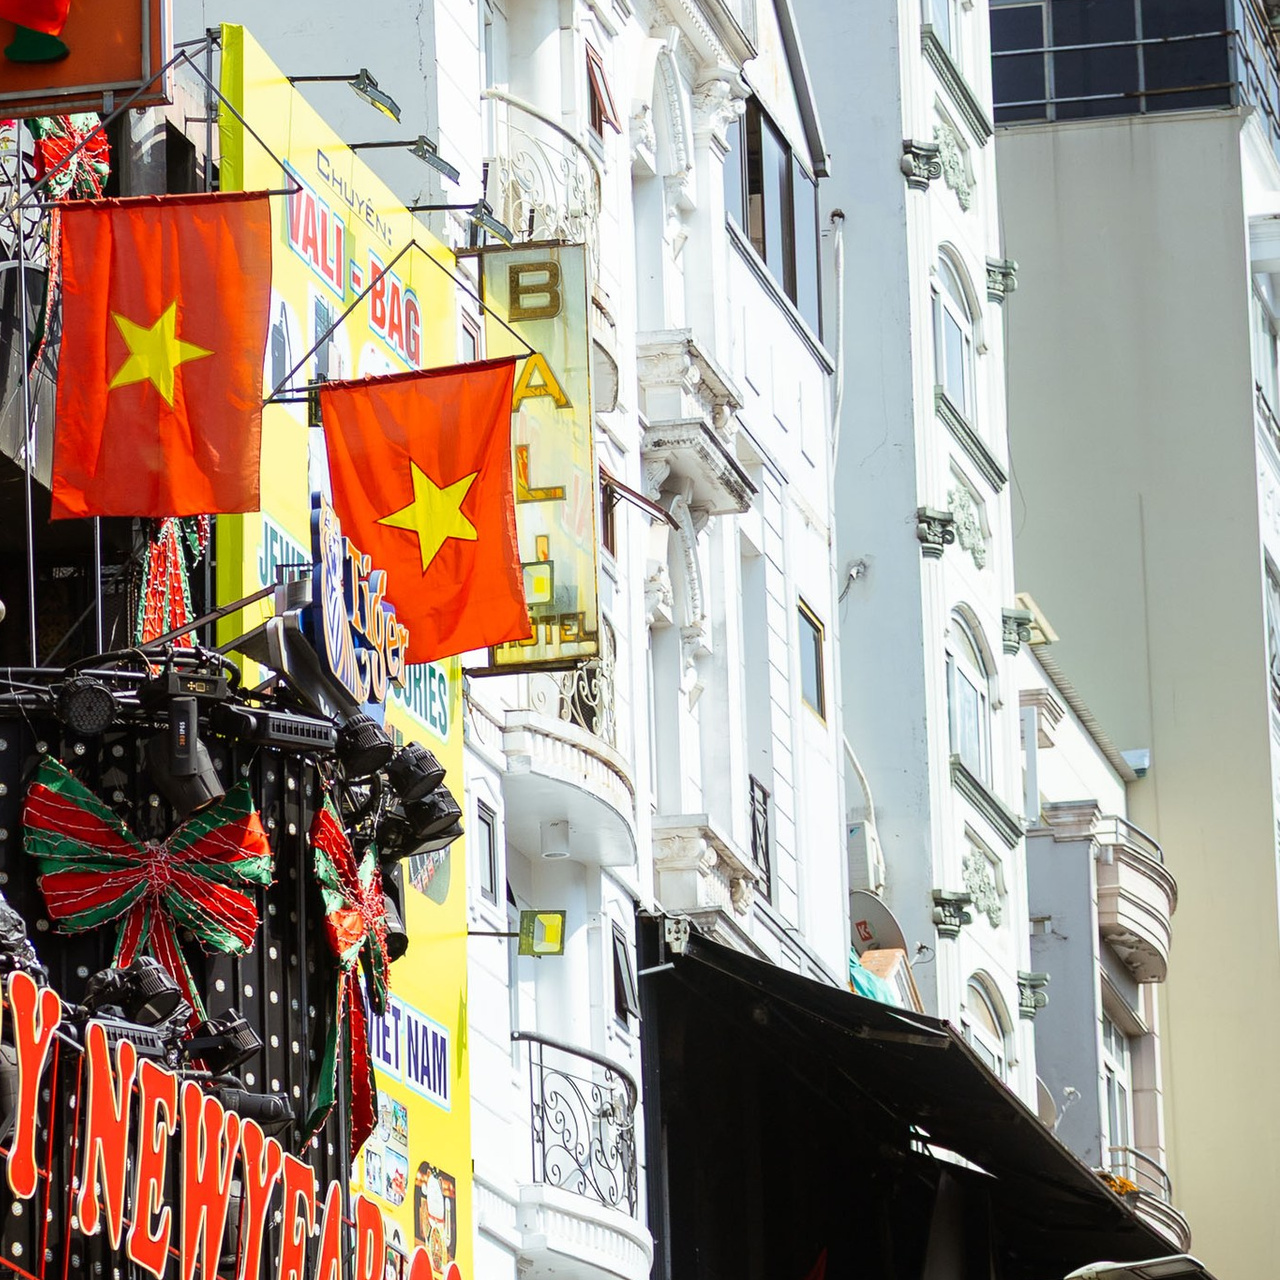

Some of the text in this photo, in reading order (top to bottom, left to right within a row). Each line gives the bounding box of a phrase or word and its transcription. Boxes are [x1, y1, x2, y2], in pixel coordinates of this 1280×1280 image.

[317, 148, 393, 247] CHUYÊN:
[286, 171, 344, 291] VALI
[371, 259, 420, 366] BAG
[342, 538, 409, 704] Tiger
[497, 610, 597, 649] OTEL
[393, 664, 448, 736] ORIES
[407, 1014, 448, 1101] NAM
